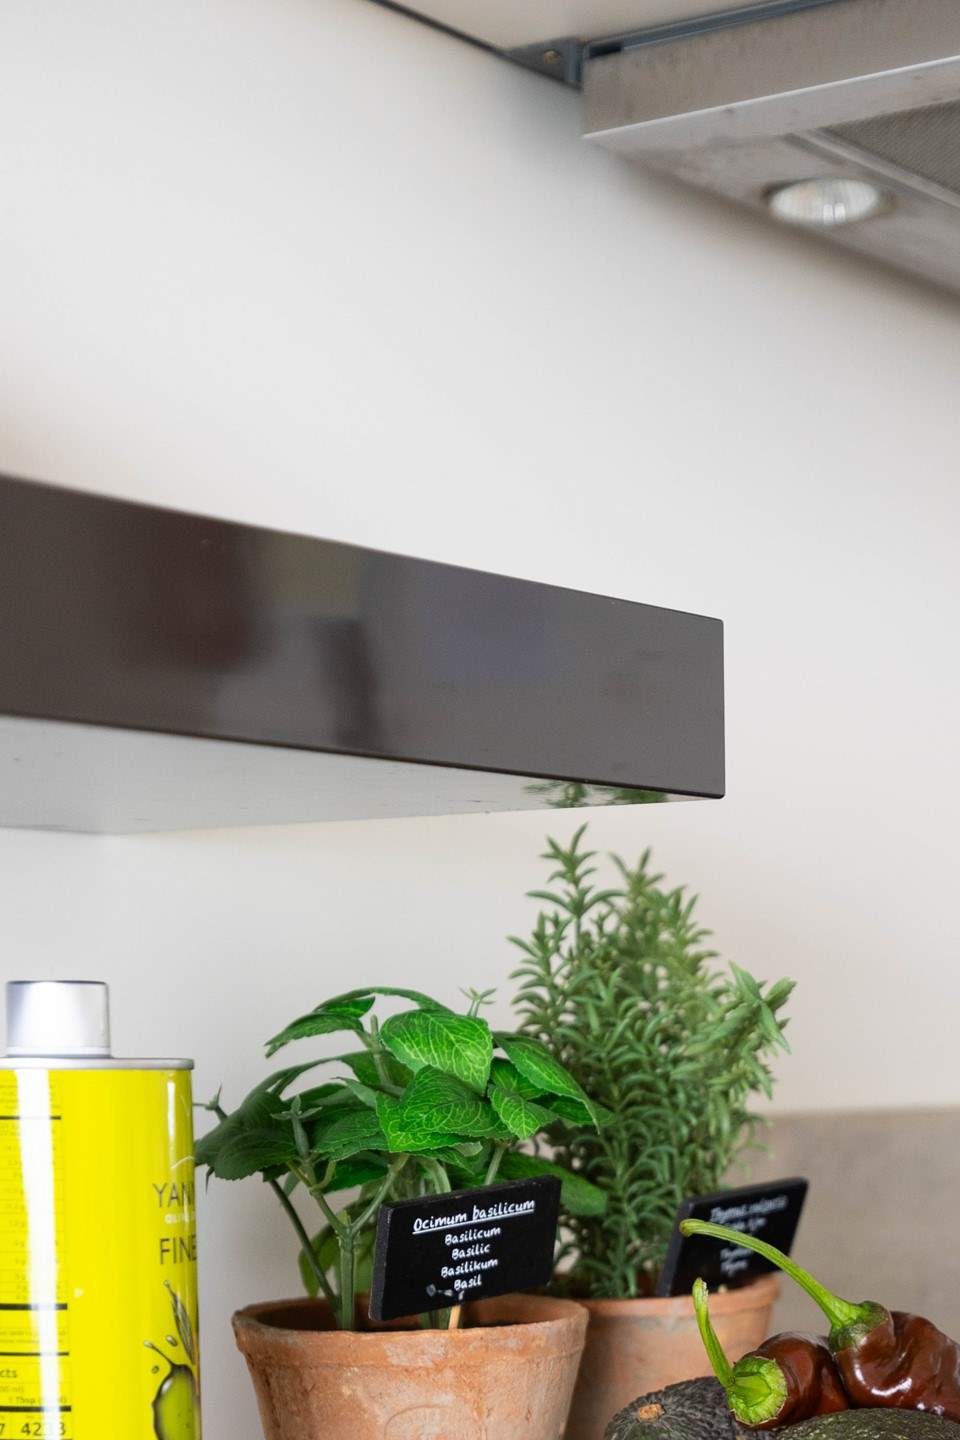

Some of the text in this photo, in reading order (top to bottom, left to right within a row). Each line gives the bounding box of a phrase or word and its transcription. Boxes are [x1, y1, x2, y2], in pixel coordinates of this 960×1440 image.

[413, 1200, 535, 1232] Ocimum basilicum
[444, 1227, 501, 1246] Basilicum
[451, 1243, 490, 1260] Basilic
[440, 1258, 498, 1278] Basilikum
[453, 1274, 482, 1291] Basil
